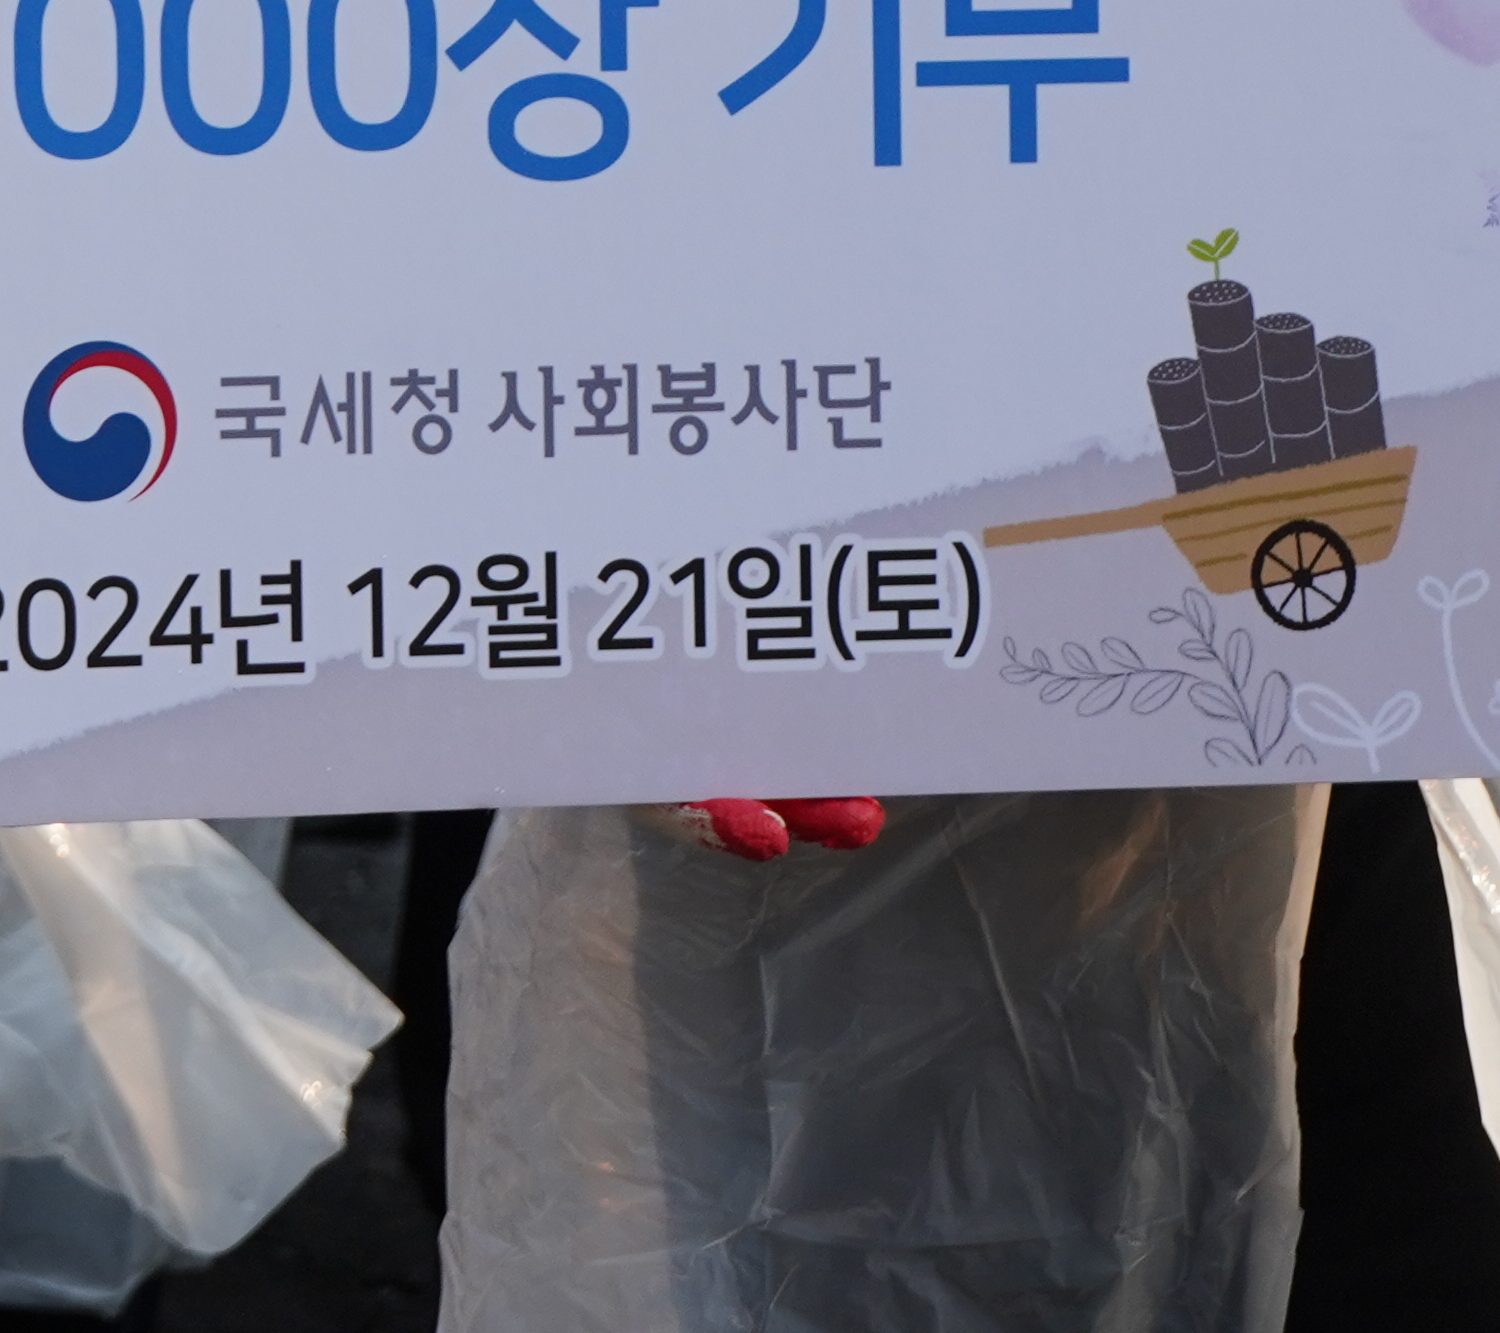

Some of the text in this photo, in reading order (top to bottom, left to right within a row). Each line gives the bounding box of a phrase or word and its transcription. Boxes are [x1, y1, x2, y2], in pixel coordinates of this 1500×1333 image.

[214, 356, 892, 458] 국세청 사회봉사단
[346, 551, 562, 669] 12월
[597, 540, 983, 662] 21일(토)
